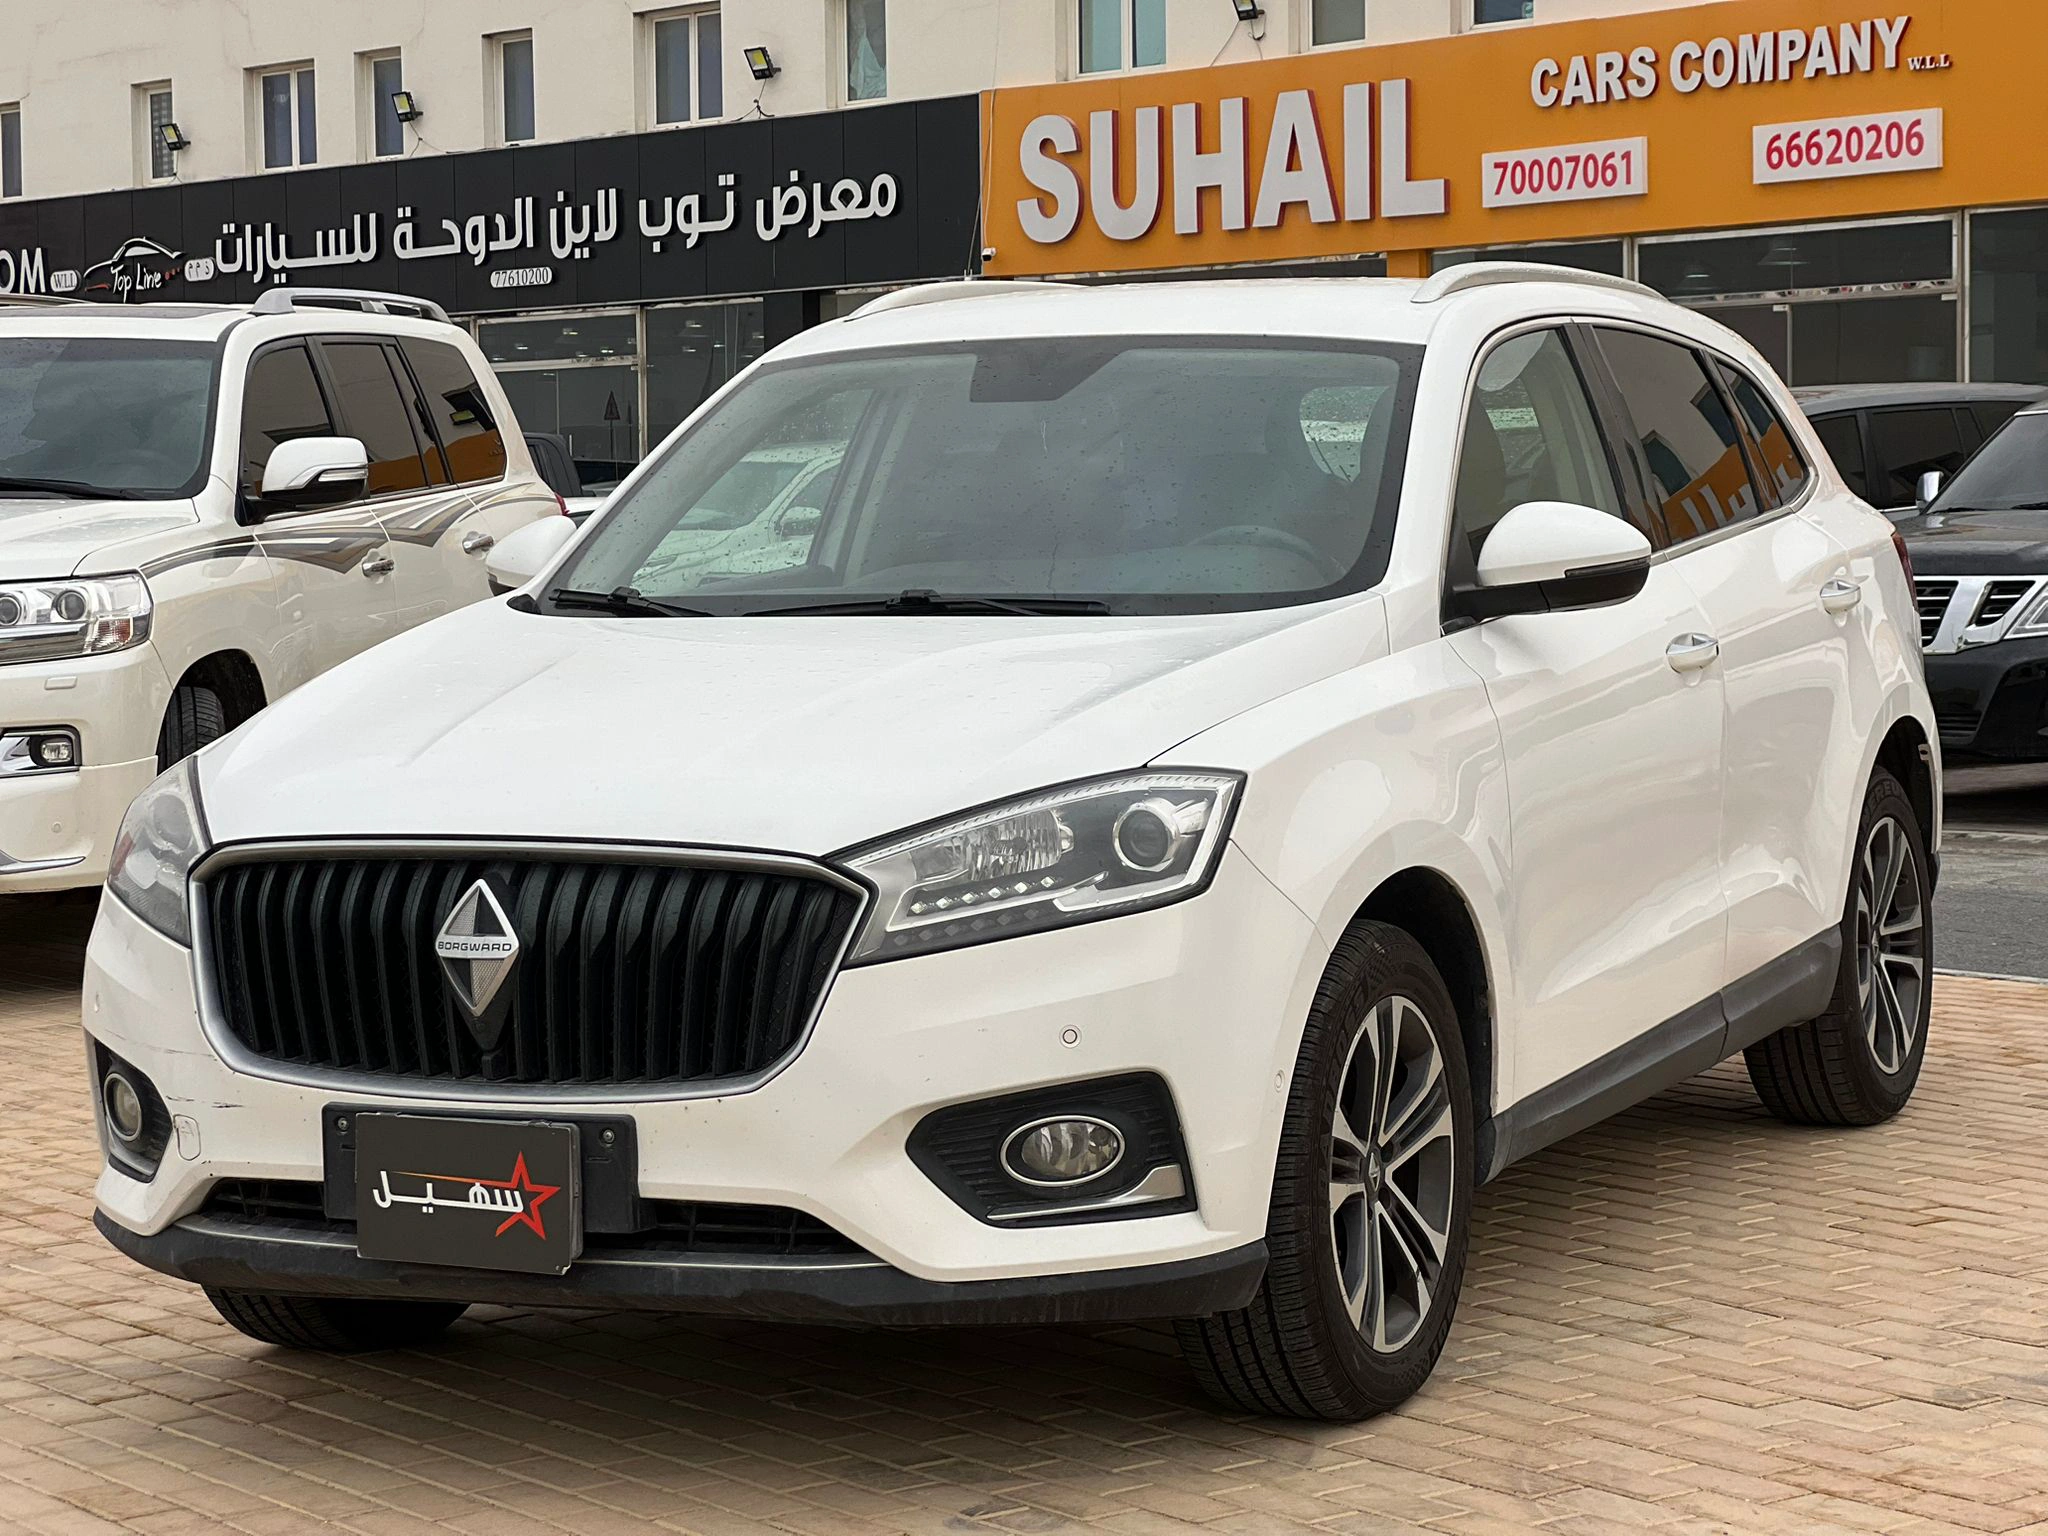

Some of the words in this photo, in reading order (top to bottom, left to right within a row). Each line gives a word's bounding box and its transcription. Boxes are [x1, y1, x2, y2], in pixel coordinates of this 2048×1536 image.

[1530, 46, 1656, 108] CARS
[1669, 16, 1911, 93] COMPANY
[1907, 54, 1951, 71] W.L.L
[1016, 77, 1449, 244] SUHAIL
[1493, 150, 1633, 196] 70007061
[1766, 118, 1925, 170] 66620206
[393, 196, 534, 266] الدوحة
[549, 187, 618, 260] لاين
[639, 173, 736, 253] توب
[755, 169, 898, 242] معرض
[110, 263, 132, 304] Top
[135, 262, 163, 291] Line
[215, 212, 378, 284] للسيارات
[494, 267, 549, 288] 77610200
[437, 941, 512, 952] BORGWARD
[372, 1170, 524, 1214] سهيل
